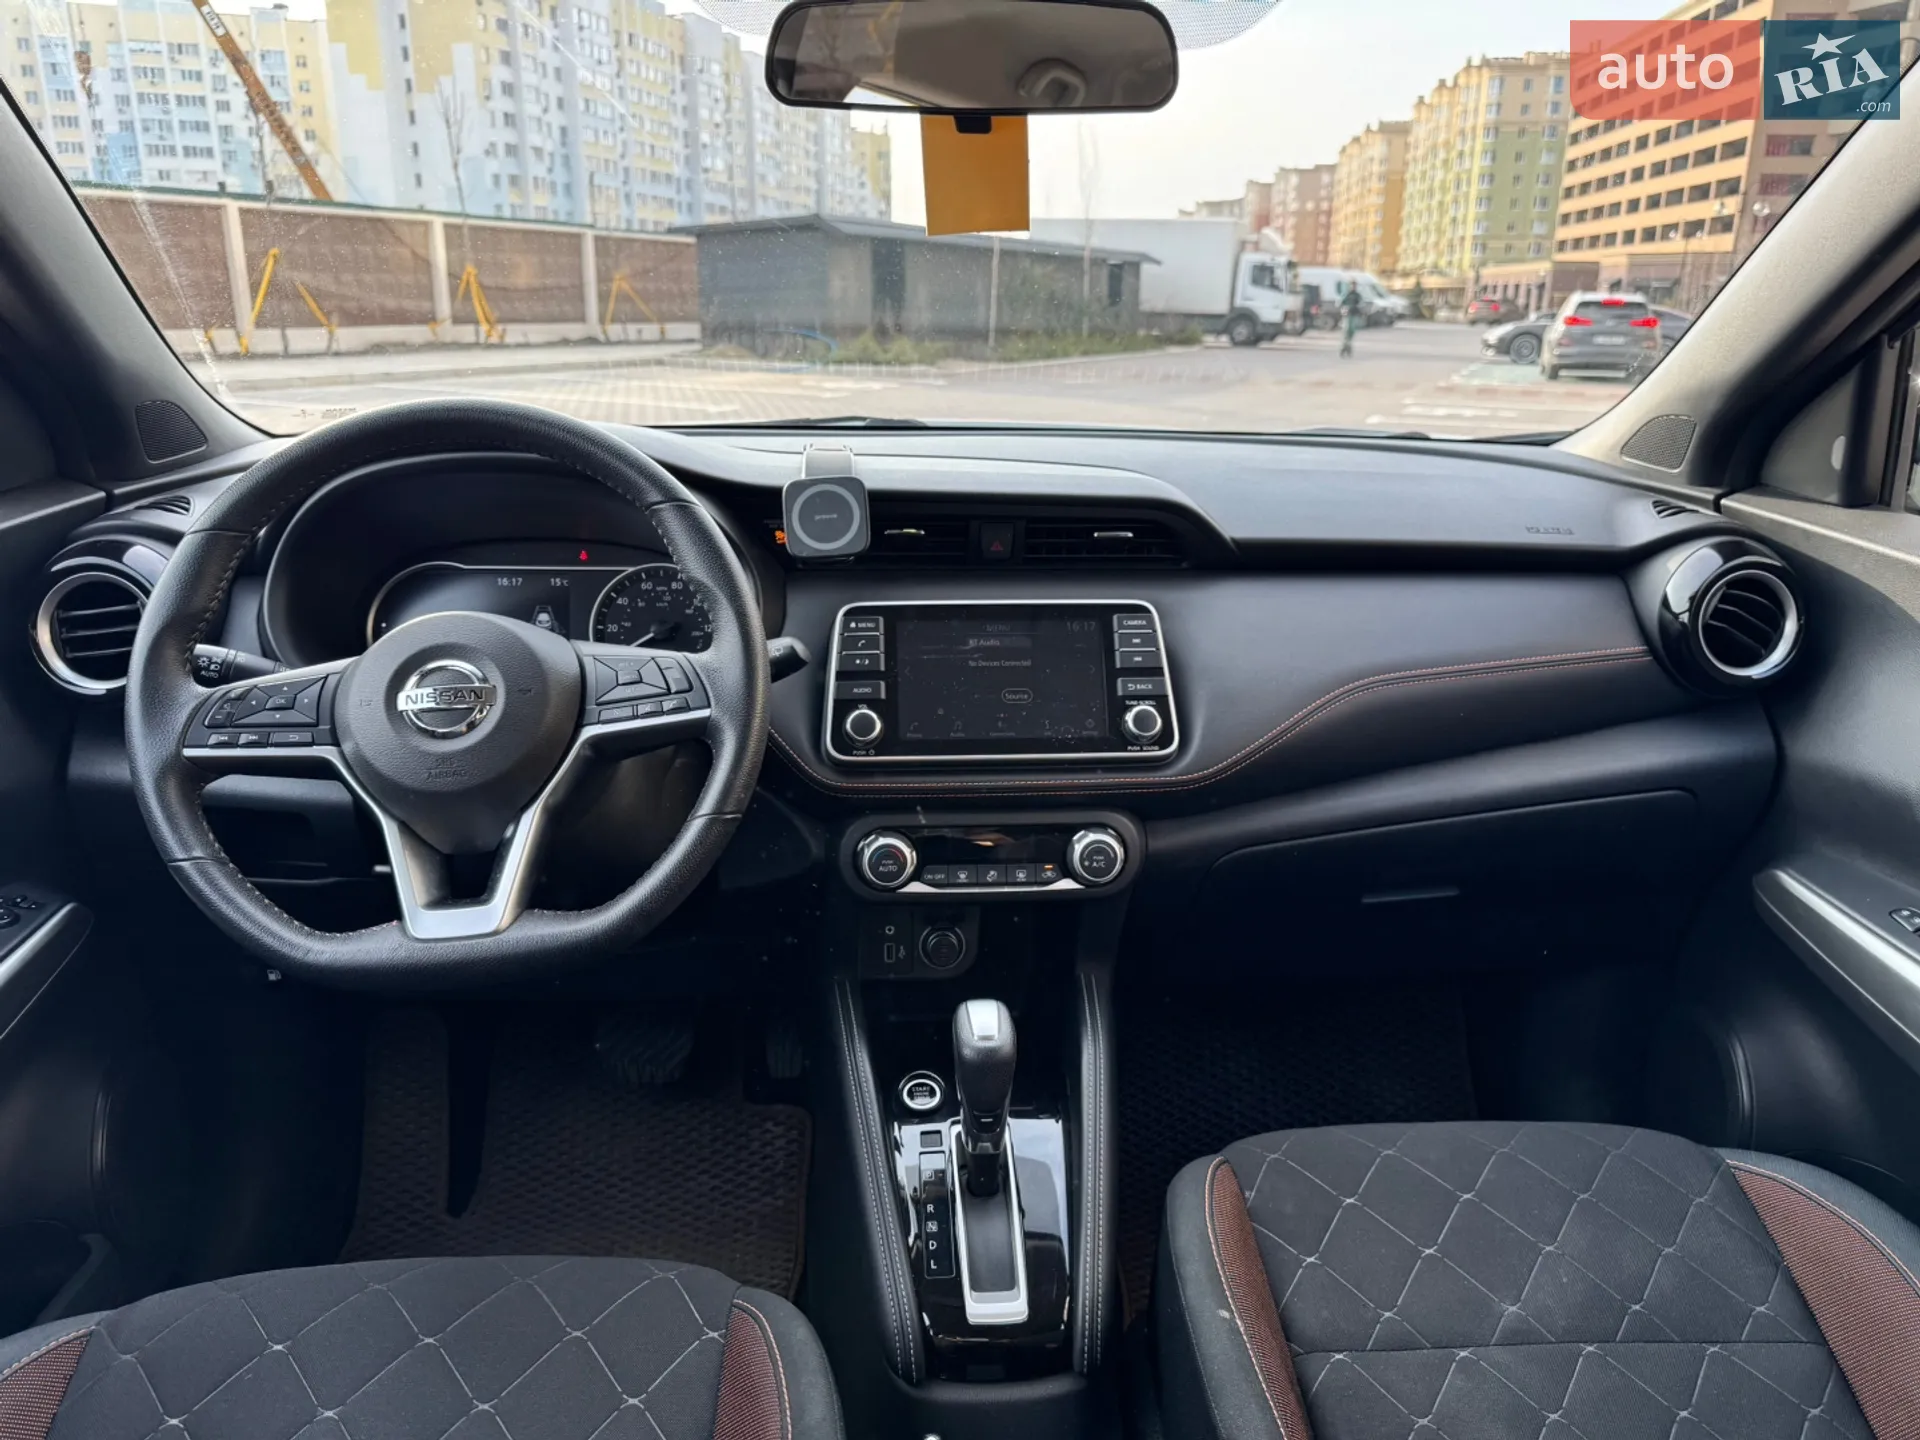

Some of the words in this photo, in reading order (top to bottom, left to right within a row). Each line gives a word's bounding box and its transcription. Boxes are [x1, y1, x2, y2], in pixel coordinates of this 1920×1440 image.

[497, 577, 523, 587] 16:17
[641, 581, 653, 590] 60
[671, 581, 683, 590] 80
[616, 597, 629, 606] 40
[606, 624, 618, 633] 20
[201, 670, 219, 679] AUTO
[405, 688, 486, 706] NISSAN
[926, 1203, 935, 1213] R
[929, 1240, 937, 1250] D
[930, 1259, 938, 1269] L
